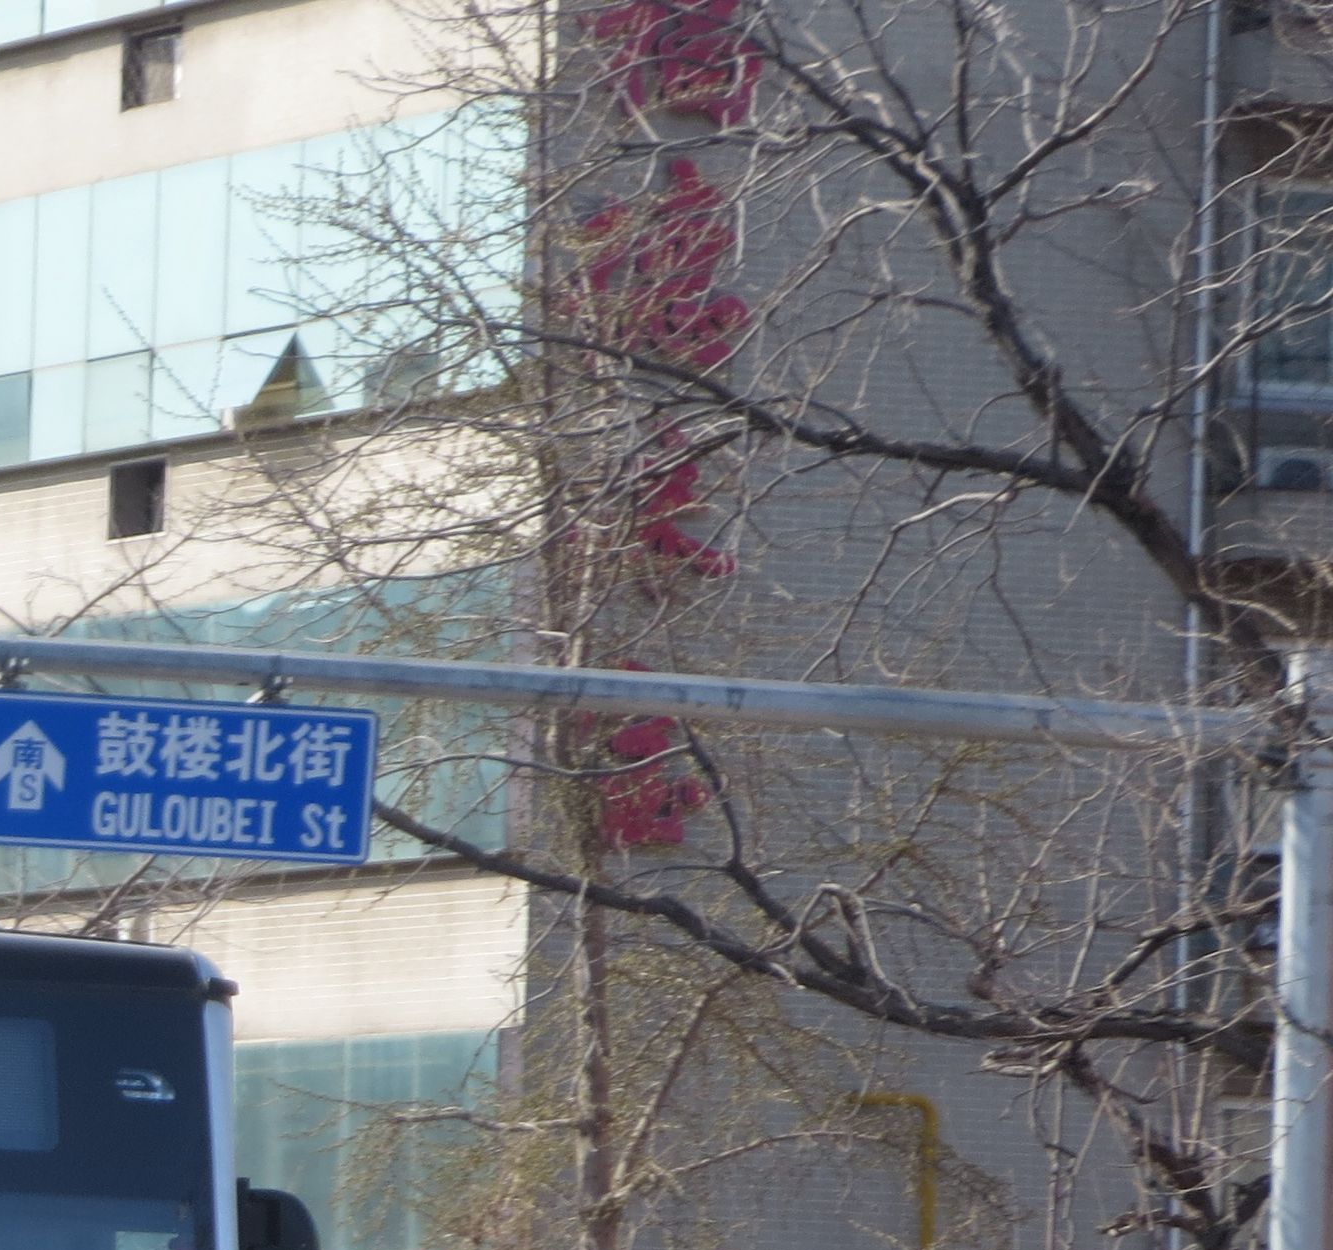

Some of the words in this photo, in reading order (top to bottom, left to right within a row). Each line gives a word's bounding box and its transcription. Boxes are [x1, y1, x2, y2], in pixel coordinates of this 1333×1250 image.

[11, 738, 44, 770] 南
[94, 711, 352, 788] 鼓楼北街
[17, 774, 37, 802] S
[92, 791, 277, 846] GULOUBEI
[299, 804, 347, 849] St
